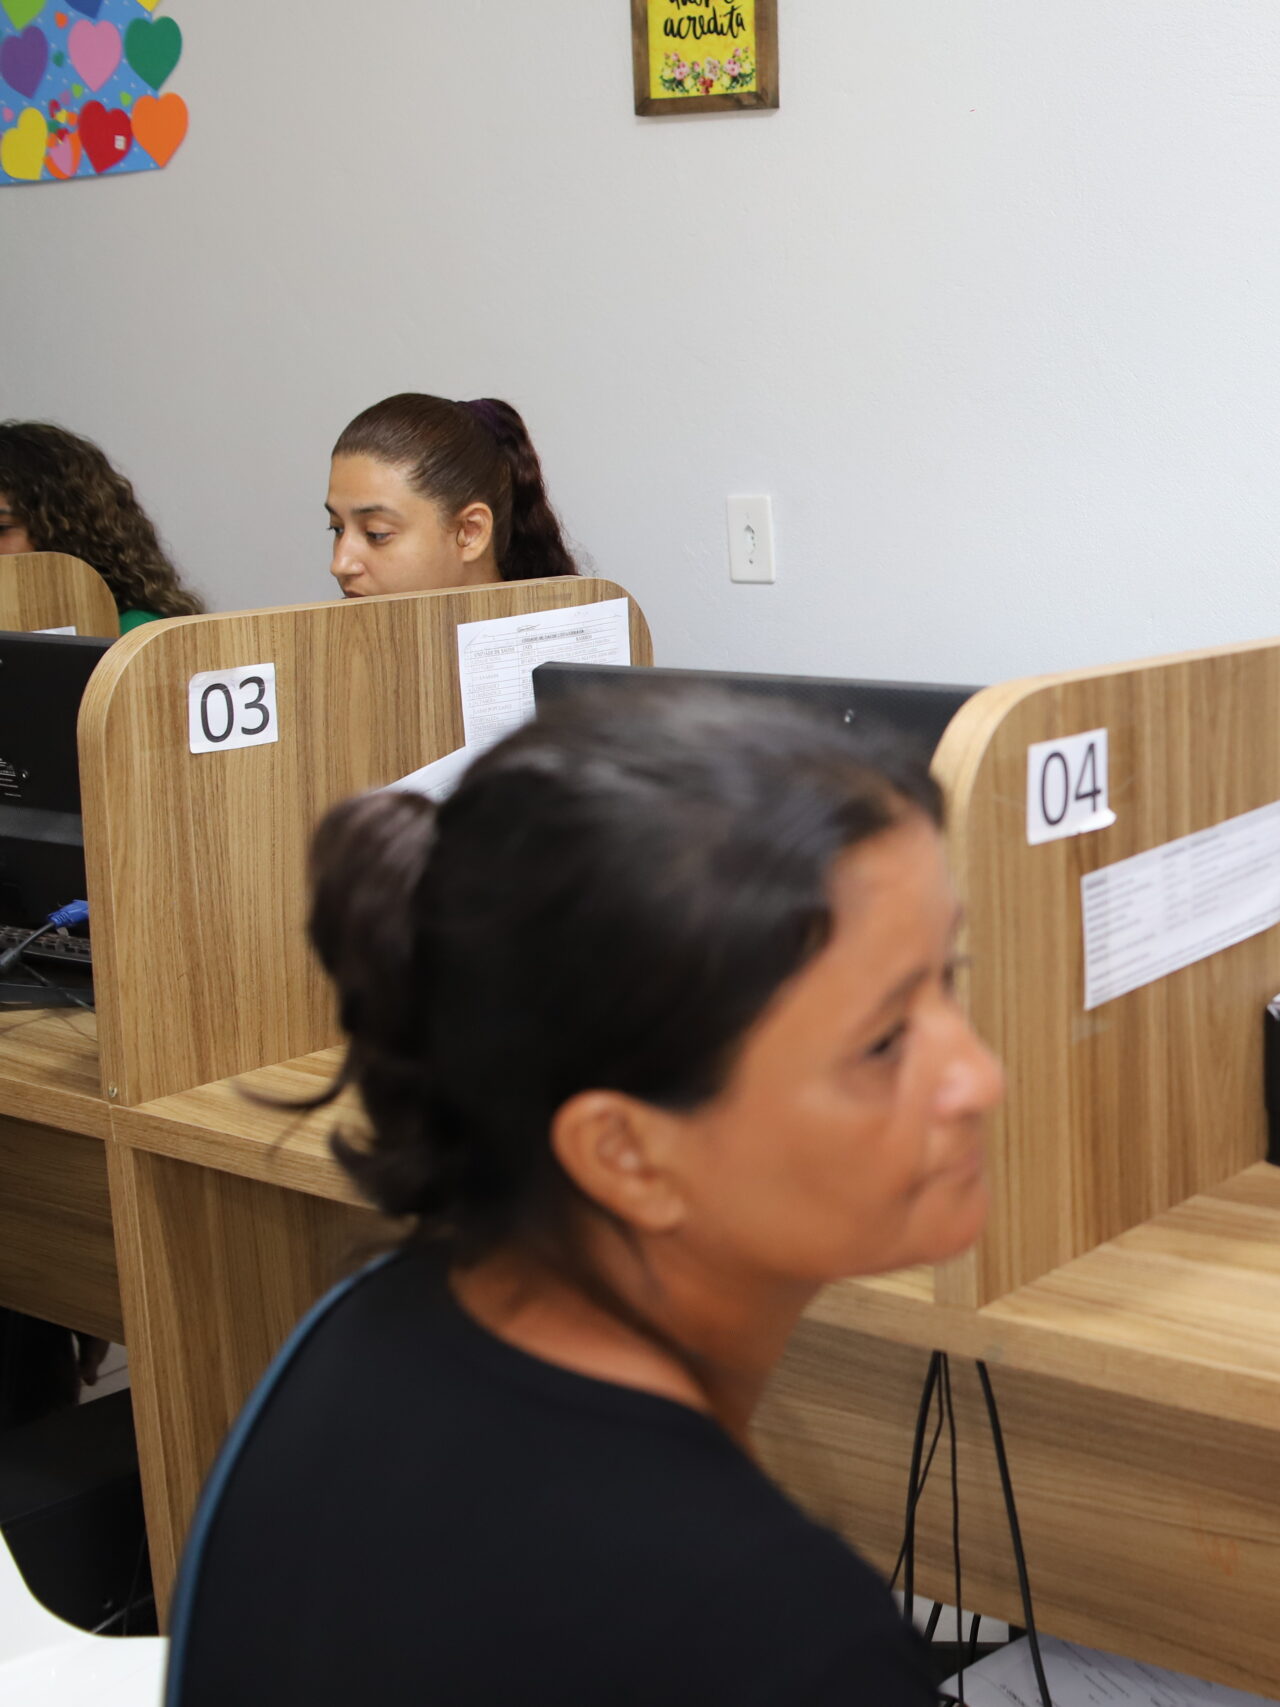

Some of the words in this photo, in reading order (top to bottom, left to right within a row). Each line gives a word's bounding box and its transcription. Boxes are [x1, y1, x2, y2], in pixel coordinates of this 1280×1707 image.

[664, 5, 746, 39] acredita
[200, 675, 270, 743] 03
[1041, 742, 1102, 826] 04
